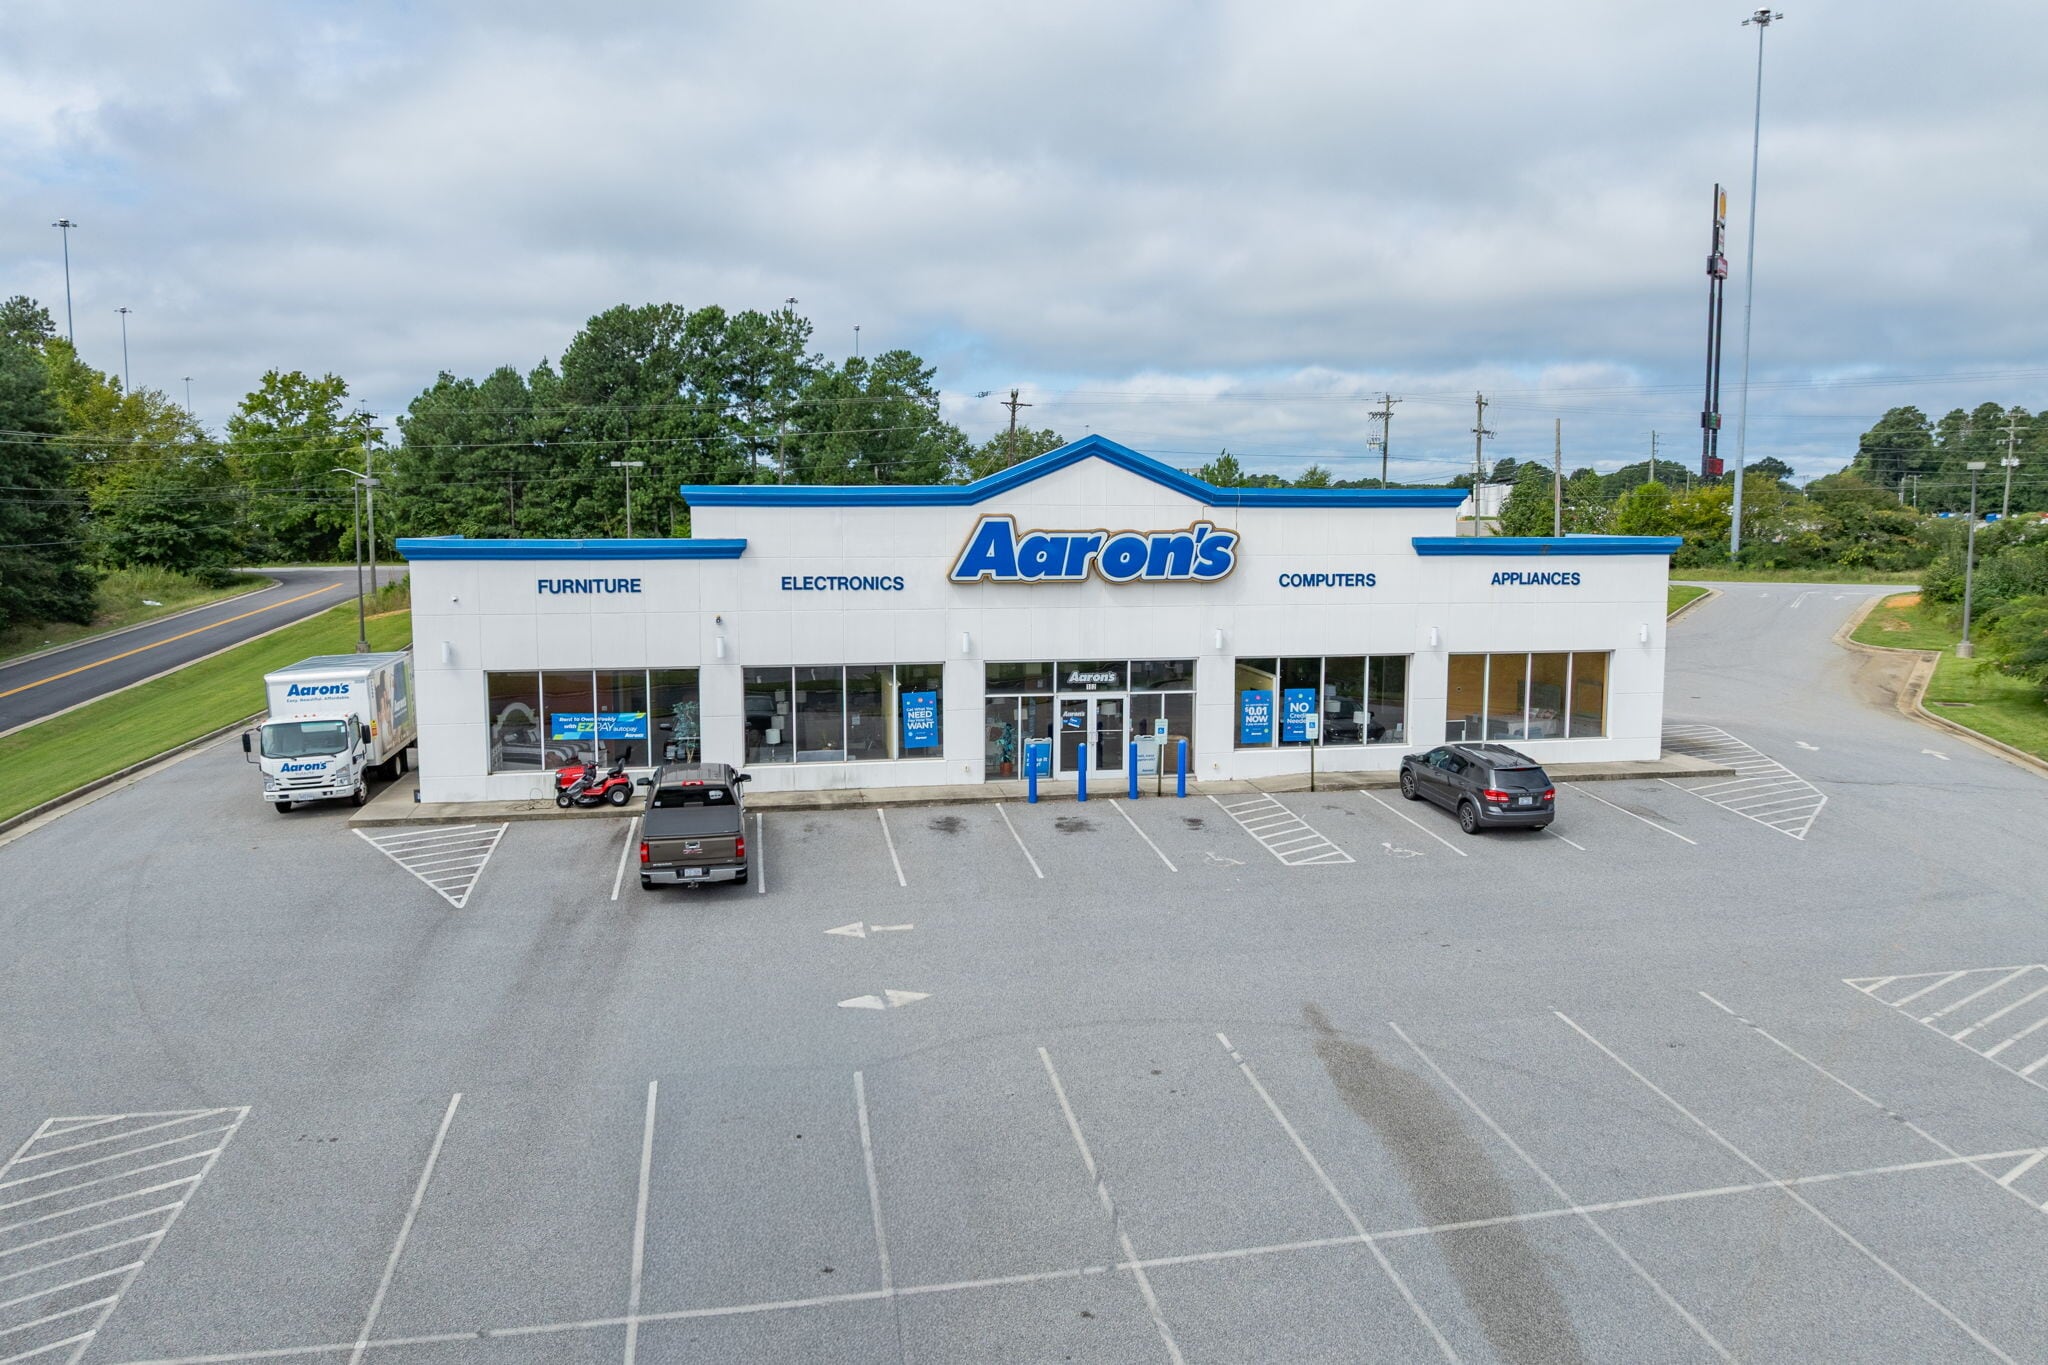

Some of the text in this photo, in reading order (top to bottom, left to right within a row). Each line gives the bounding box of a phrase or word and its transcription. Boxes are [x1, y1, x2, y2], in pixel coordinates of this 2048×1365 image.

[951, 517, 1237, 581] Aaron's
[780, 576, 905, 591] ELECTRONICS
[1278, 573, 1377, 588] COMPUTERS
[1490, 572, 1581, 586] APPLIANCES
[537, 578, 642, 594] FURNITURE
[1068, 671, 1116, 683] Aaron's
[287, 683, 349, 697] Aaron's
[1244, 706, 1268, 715] $0.01
[1290, 702, 1309, 712] NO
[907, 710, 933, 719] NEED
[1245, 715, 1268, 723] NOW
[907, 721, 935, 730] WANT
[280, 761, 327, 773] Aaron's
